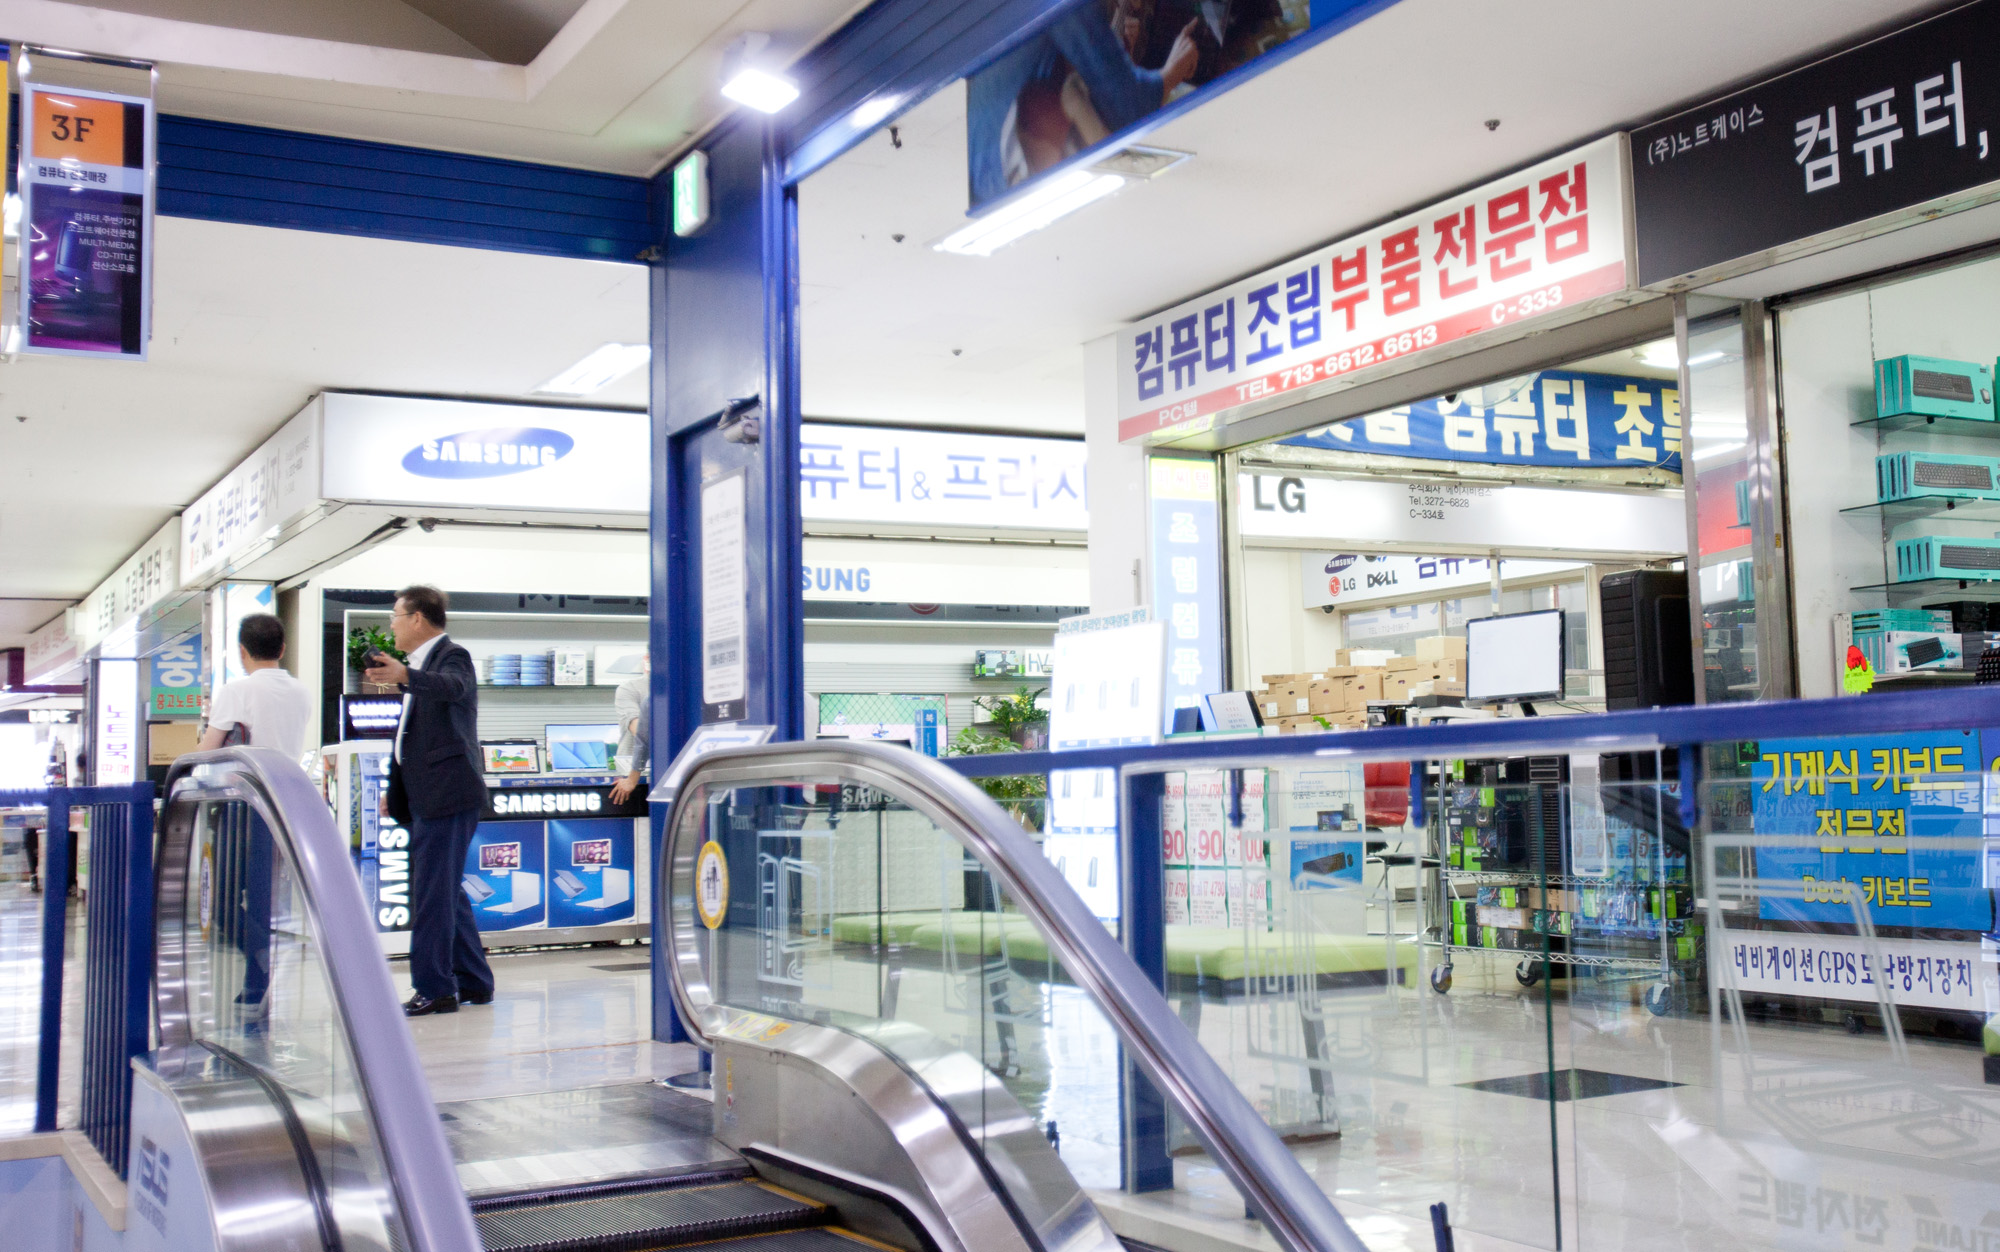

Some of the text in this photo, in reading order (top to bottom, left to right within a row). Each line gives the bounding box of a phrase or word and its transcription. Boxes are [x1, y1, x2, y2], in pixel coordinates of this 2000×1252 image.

[51, 114, 94, 142] 3F
[1647, 104, 1764, 165] (주)노트케이스
[38, 165, 66, 179] 컴퓨터
[79, 238, 135, 250] MULTI-MEDIA
[97, 251, 135, 261] CD-TITLE
[1491, 285, 1564, 326] C-333
[1236, 325, 1438, 402] TEL 713-6612.6613
[422, 440, 558, 467] SAMSUNG
[1253, 476, 1307, 513] LG
[1409, 508, 1445, 519] C-334호
[1328, 556, 1355, 569] SAMSUNG
[1343, 570, 1398, 592] LG DELL
[105, 704, 130, 760] 노트북
[1761, 749, 1860, 796] 기계식
[1871, 746, 1966, 795] 키보드
[493, 793, 602, 813] SAMSUNG
[1815, 807, 1909, 855] 전문점
[1861, 876, 1932, 907] 키보드
